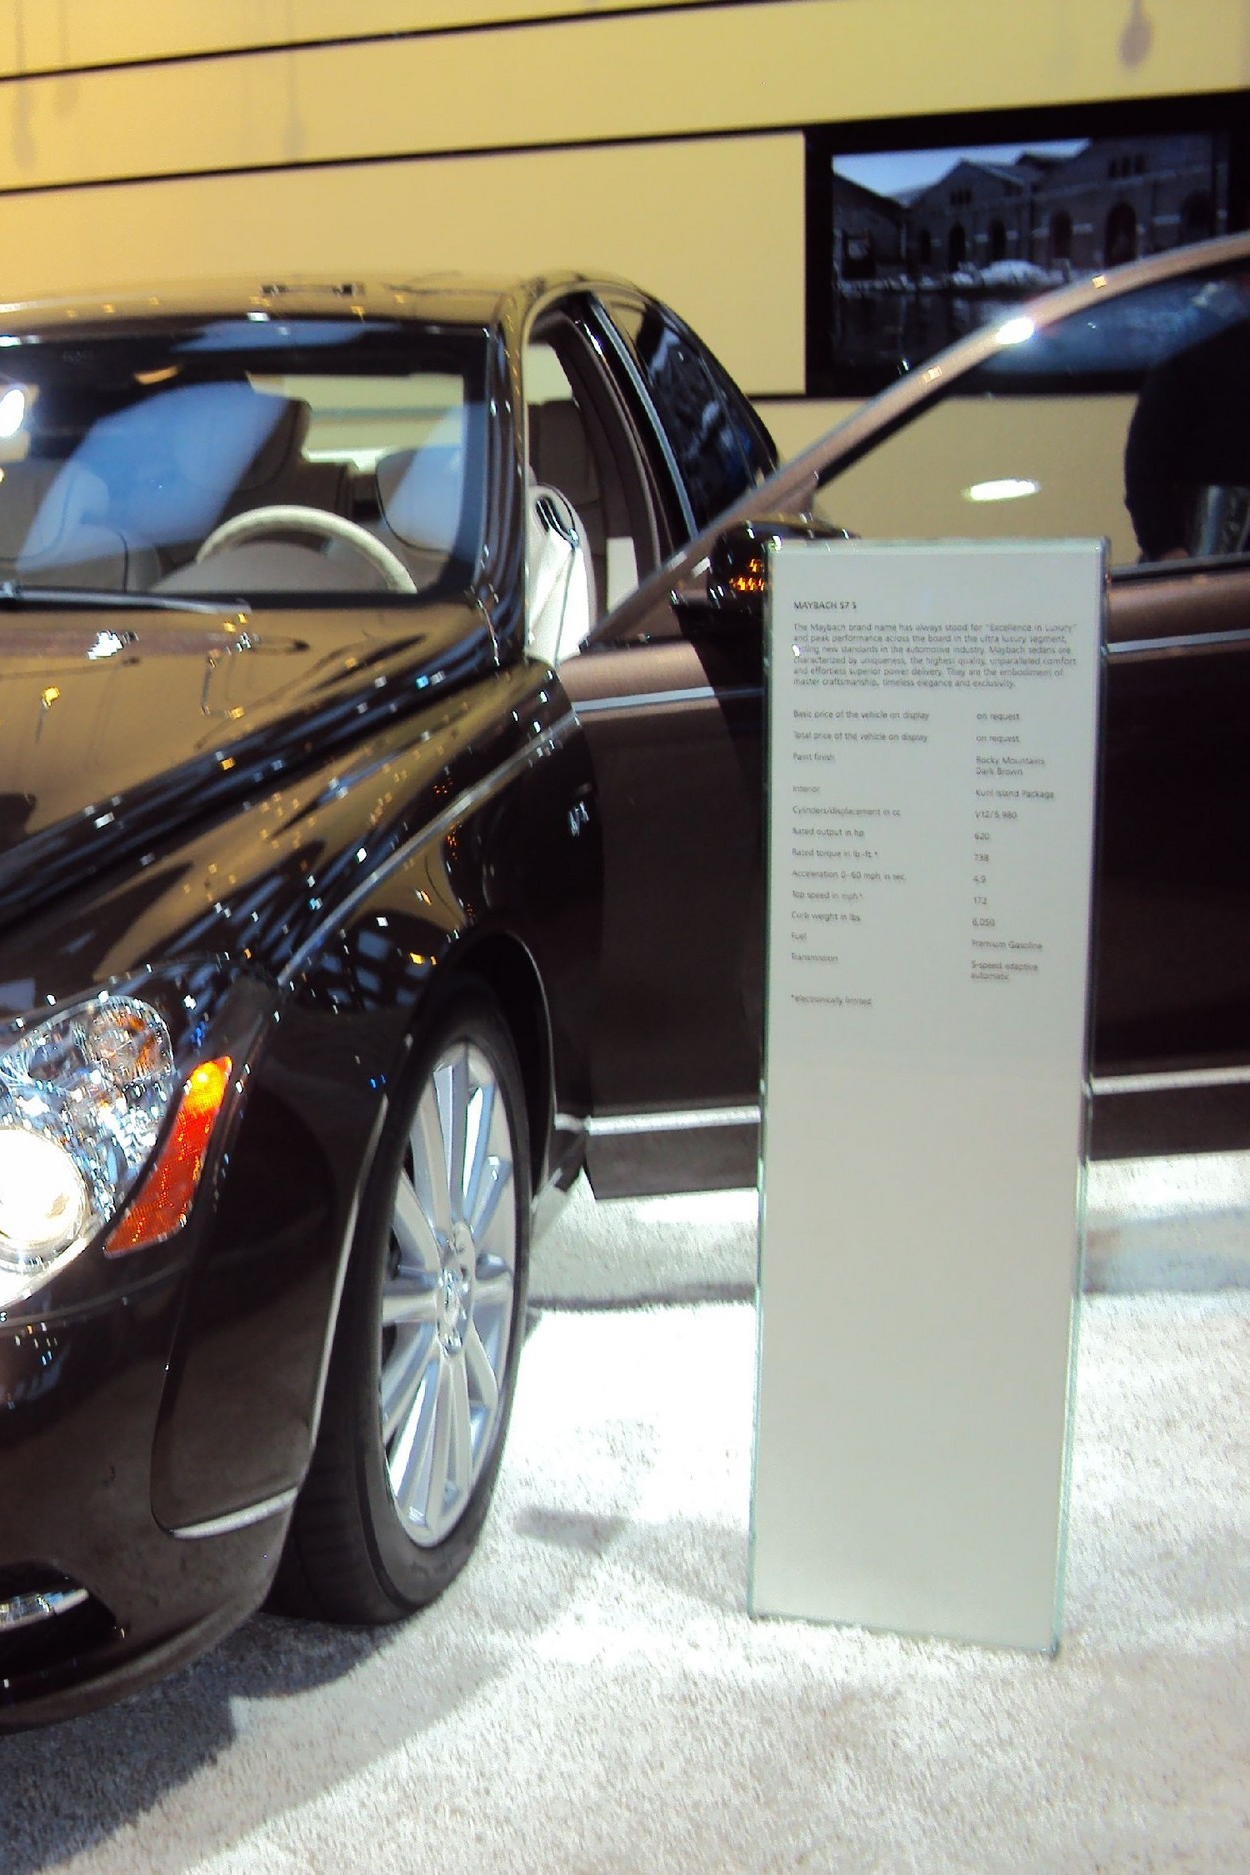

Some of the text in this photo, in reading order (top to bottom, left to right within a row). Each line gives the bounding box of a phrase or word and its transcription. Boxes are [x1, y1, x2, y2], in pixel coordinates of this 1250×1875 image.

[793, 601, 838, 610] MAYBACH
[840, 601, 850, 610] 57
[794, 623, 808, 631] The
[810, 623, 846, 633] Maybach
[848, 623, 872, 631] brand
[898, 623, 912, 632] has
[915, 623, 942, 633] always
[945, 623, 968, 632] stood
[794, 634, 808, 642] and
[810, 634, 830, 644] peak
[832, 634, 882, 644] performance
[912, 634, 925, 642] the
[928, 634, 952, 642] board
[964, 634, 978, 643] the
[792, 646, 820, 655] tting
[841, 646, 878, 654] standards
[891, 646, 904, 654] the
[906, 646, 950, 654] automotive
[988, 646, 1025, 656] Maybach
[1028, 646, 1056, 654] sedans
[910, 657, 923, 665] the
[926, 657, 955, 666] highest
[990, 658, 1040, 667] unparalleled
[794, 667, 808, 675] and
[810, 667, 846, 675] effortless
[848, 668, 880, 677] superior
[884, 669, 908, 677] power
[946, 668, 966, 677] They
[983, 668, 996, 676] the
[794, 678, 820, 686] master
[916, 679, 952, 688] elegance
[954, 679, 970, 687] and
[814, 710, 834, 720] price
[846, 710, 858, 718] the
[860, 710, 888, 719] vehicle
[902, 711, 929, 721] display
[990, 713, 1020, 722] request
[794, 731, 812, 739] Total
[814, 732, 832, 741] price
[844, 732, 858, 740] the
[860, 732, 886, 741] vehicle
[901, 733, 928, 743] display
[989, 735, 1020, 744] request
[792, 753, 836, 762] Paint finish
[976, 756, 999, 765] Rocky
[976, 767, 1023, 776] Dark Brown
[792, 785, 820, 793] Interior
[1022, 790, 1054, 800] Package
[792, 827, 814, 836] Rated
[816, 828, 842, 837] output
[792, 848, 814, 856] Rated
[816, 850, 842, 858] torque
[792, 870, 838, 878] Acceleration
[864, 872, 880, 880] mph
[806, 892, 830, 900] speed
[791, 911, 810, 920] Curb
[811, 912, 838, 922] weight
[791, 932, 807, 940] Fuel
[972, 939, 1043, 950] Premium Gasoline
[791, 953, 838, 962] Transmission
[970, 972, 1009, 980] automatic
[845, 996, 872, 1006] limited
